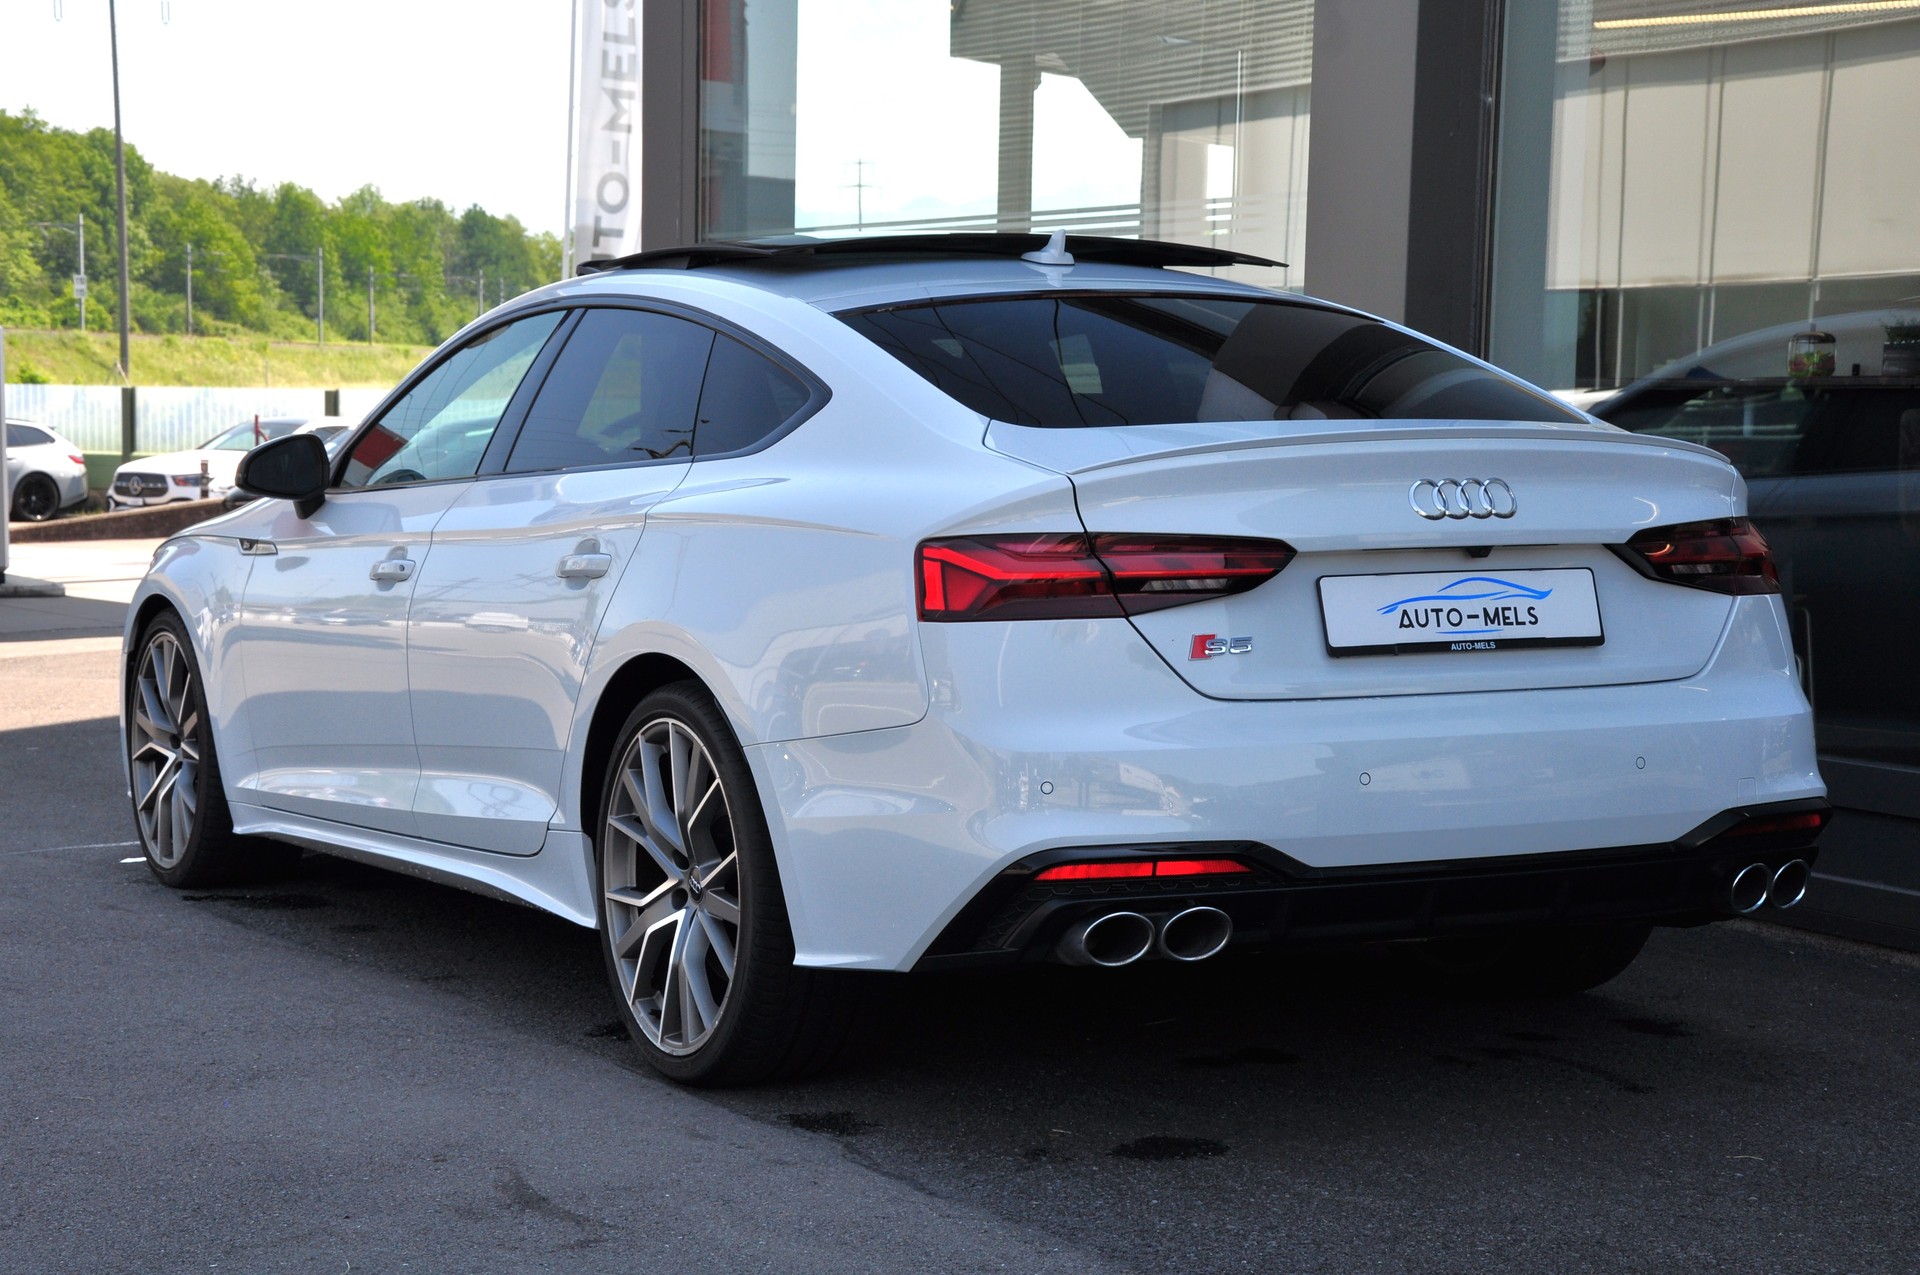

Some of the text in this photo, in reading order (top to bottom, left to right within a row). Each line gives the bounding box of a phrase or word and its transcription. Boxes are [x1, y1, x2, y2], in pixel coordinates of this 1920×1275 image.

[1399, 606, 1539, 629] AUTO-MELS
[1204, 636, 1253, 656] S5
[1451, 641, 1496, 651] AUTO-MELS
